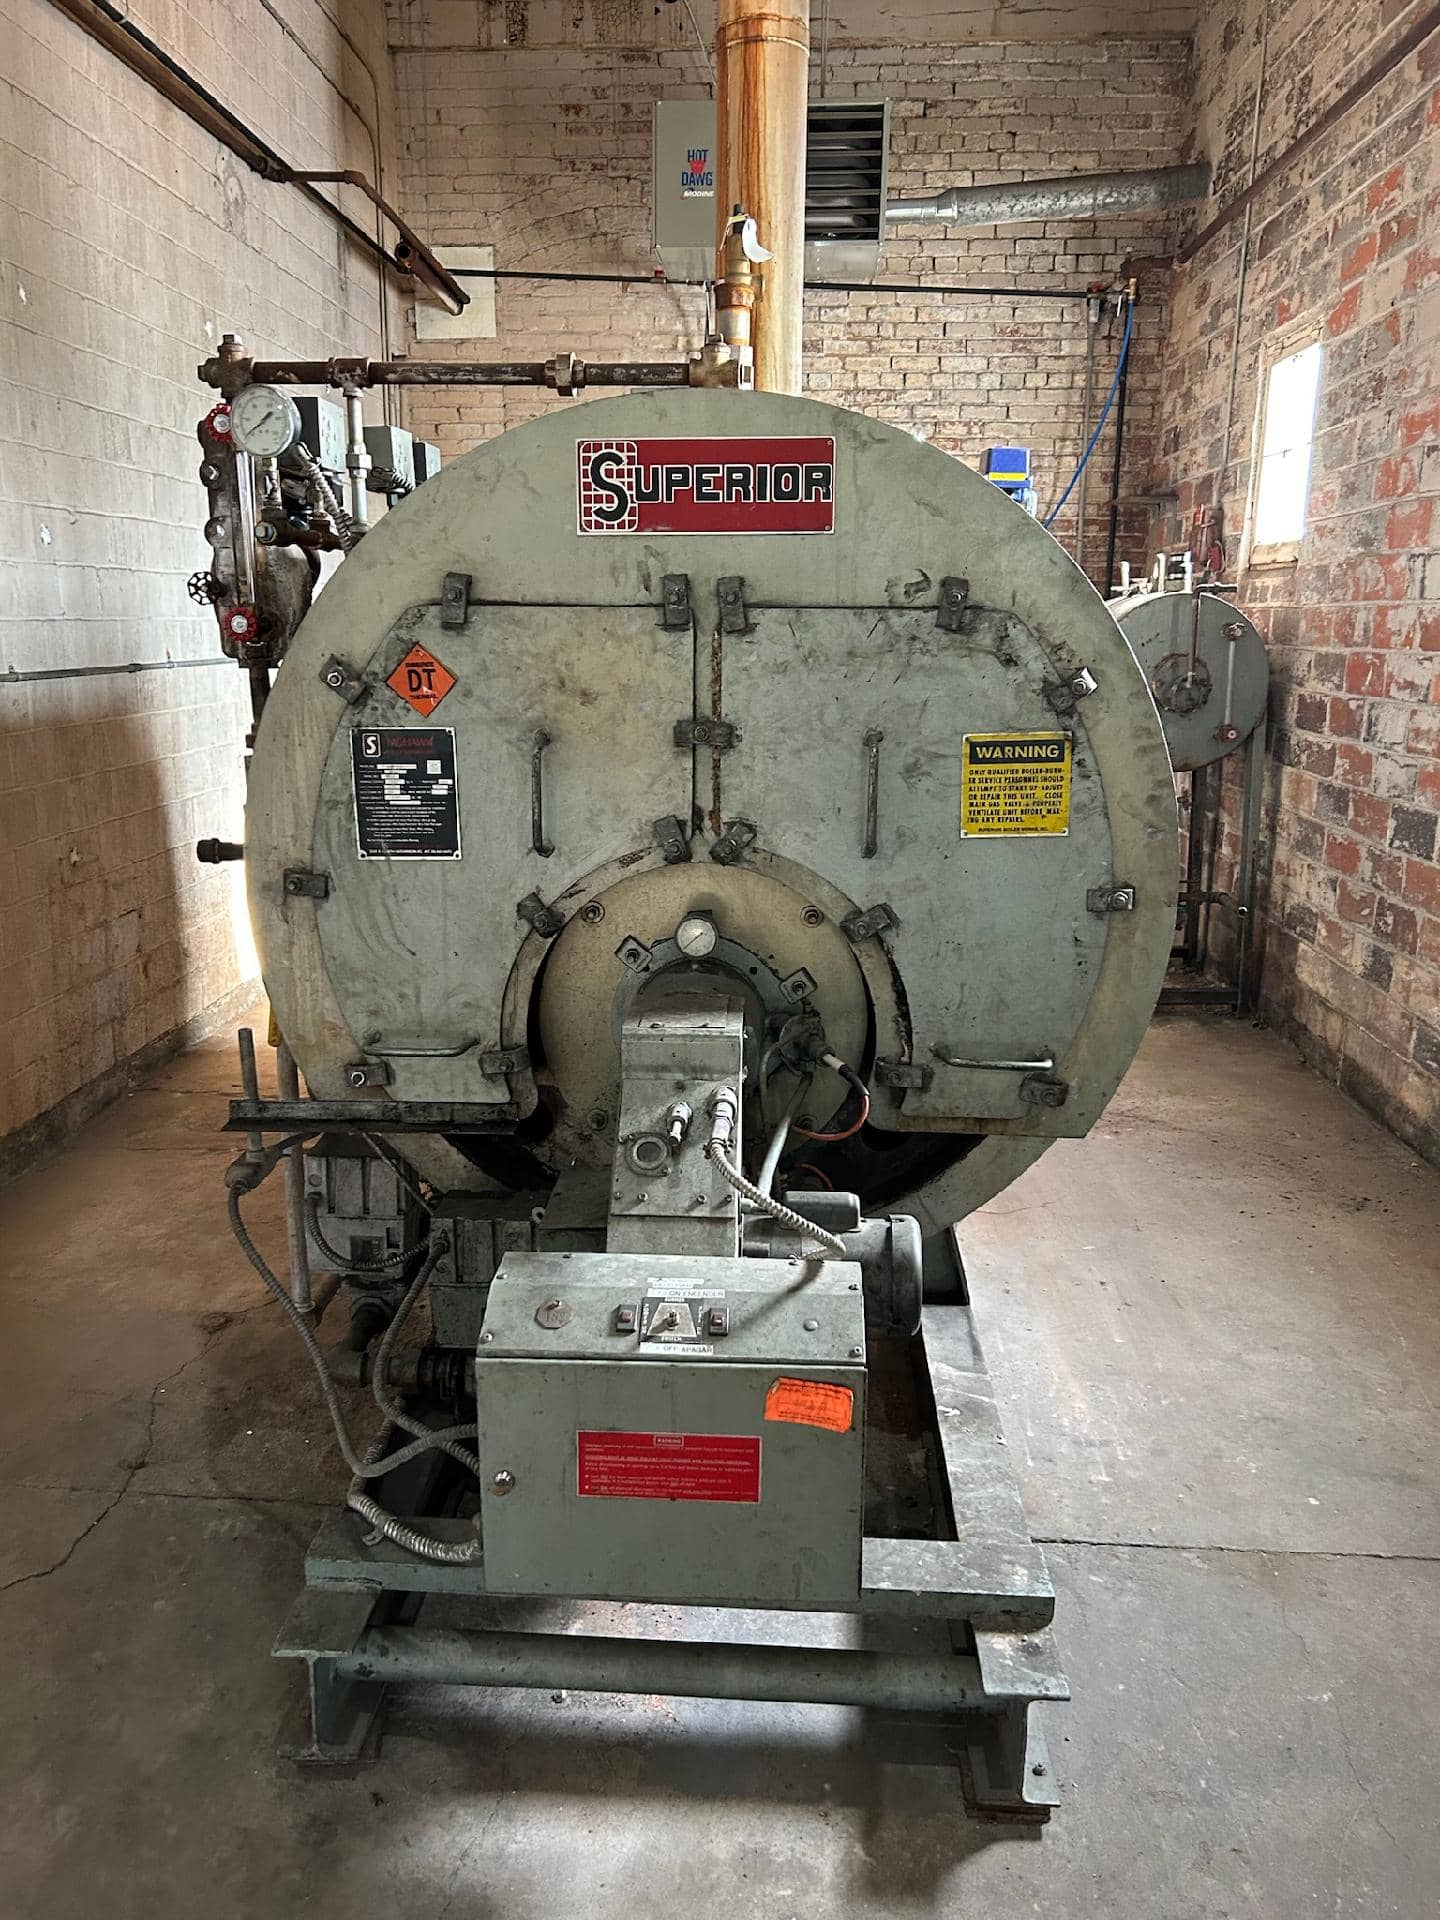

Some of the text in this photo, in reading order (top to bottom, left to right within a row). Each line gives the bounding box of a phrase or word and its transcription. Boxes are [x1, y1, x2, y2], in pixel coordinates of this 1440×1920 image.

[687, 149, 709, 163] HOT
[681, 171, 713, 186] DAWG
[589, 450, 833, 523] SUPERIOR
[407, 668, 436, 692] DT
[975, 744, 1060, 759] WARNING
